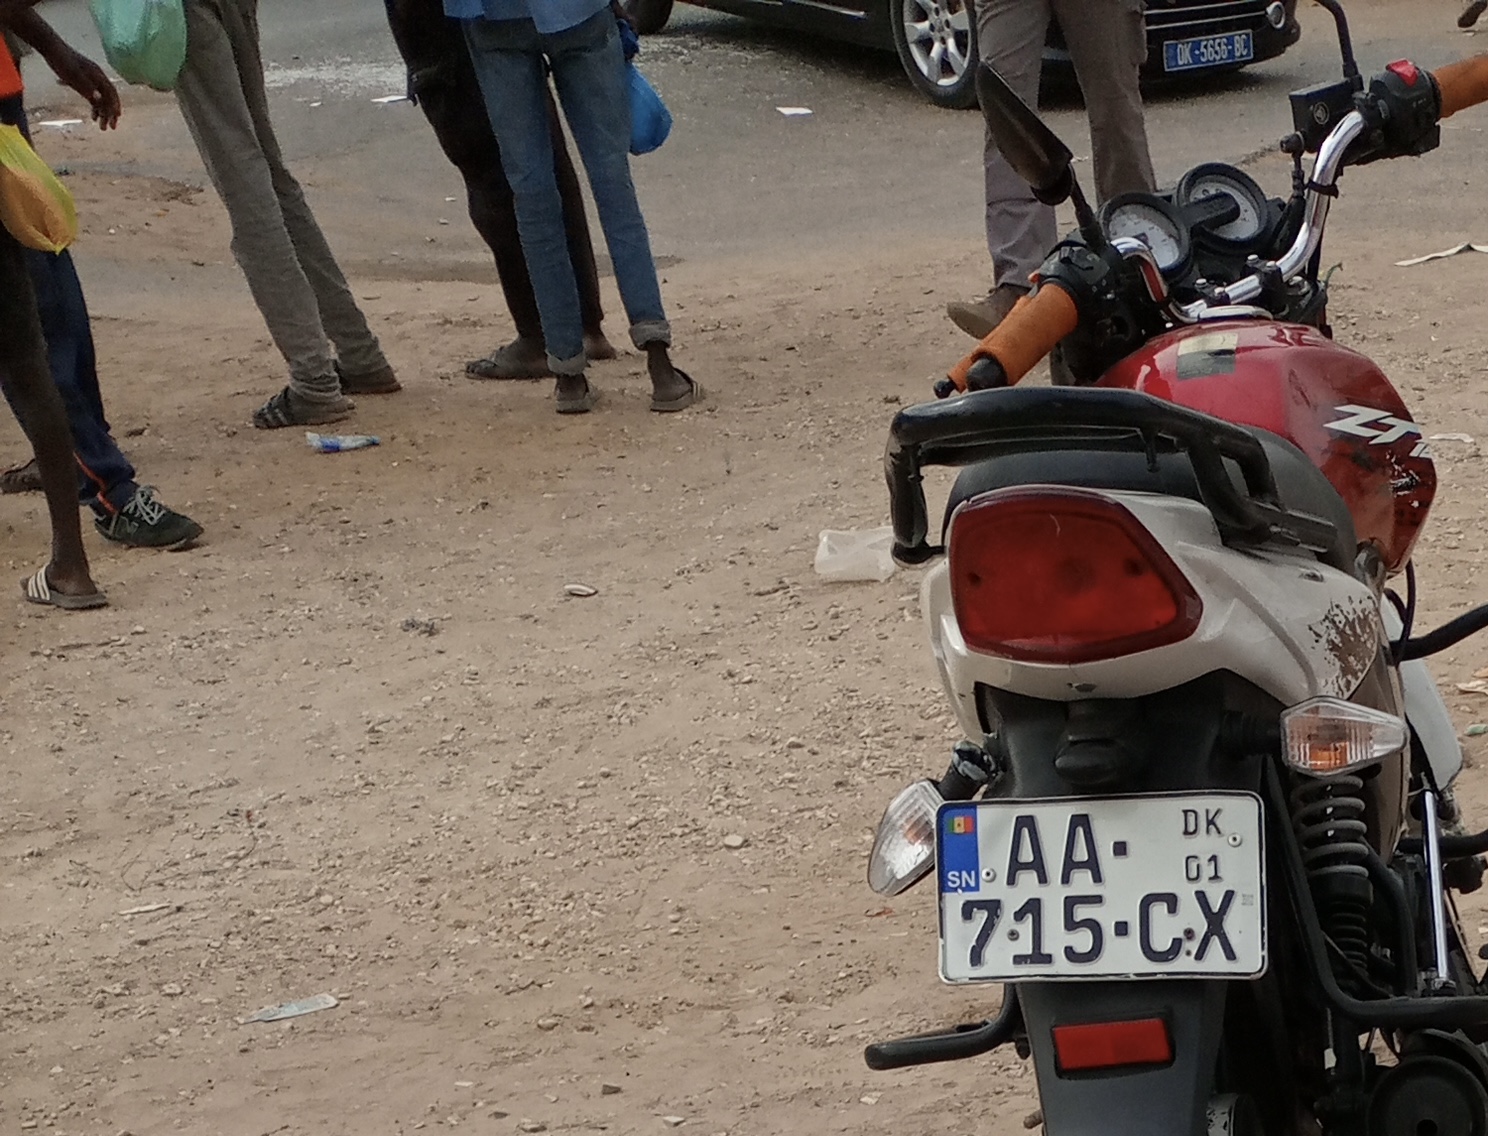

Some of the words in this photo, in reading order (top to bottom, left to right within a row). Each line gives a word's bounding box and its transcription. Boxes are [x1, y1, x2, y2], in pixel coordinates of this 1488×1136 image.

[1182, 809, 1222, 836] DK
[947, 869, 976, 889] SN
[1184, 855, 1223, 882] 01
